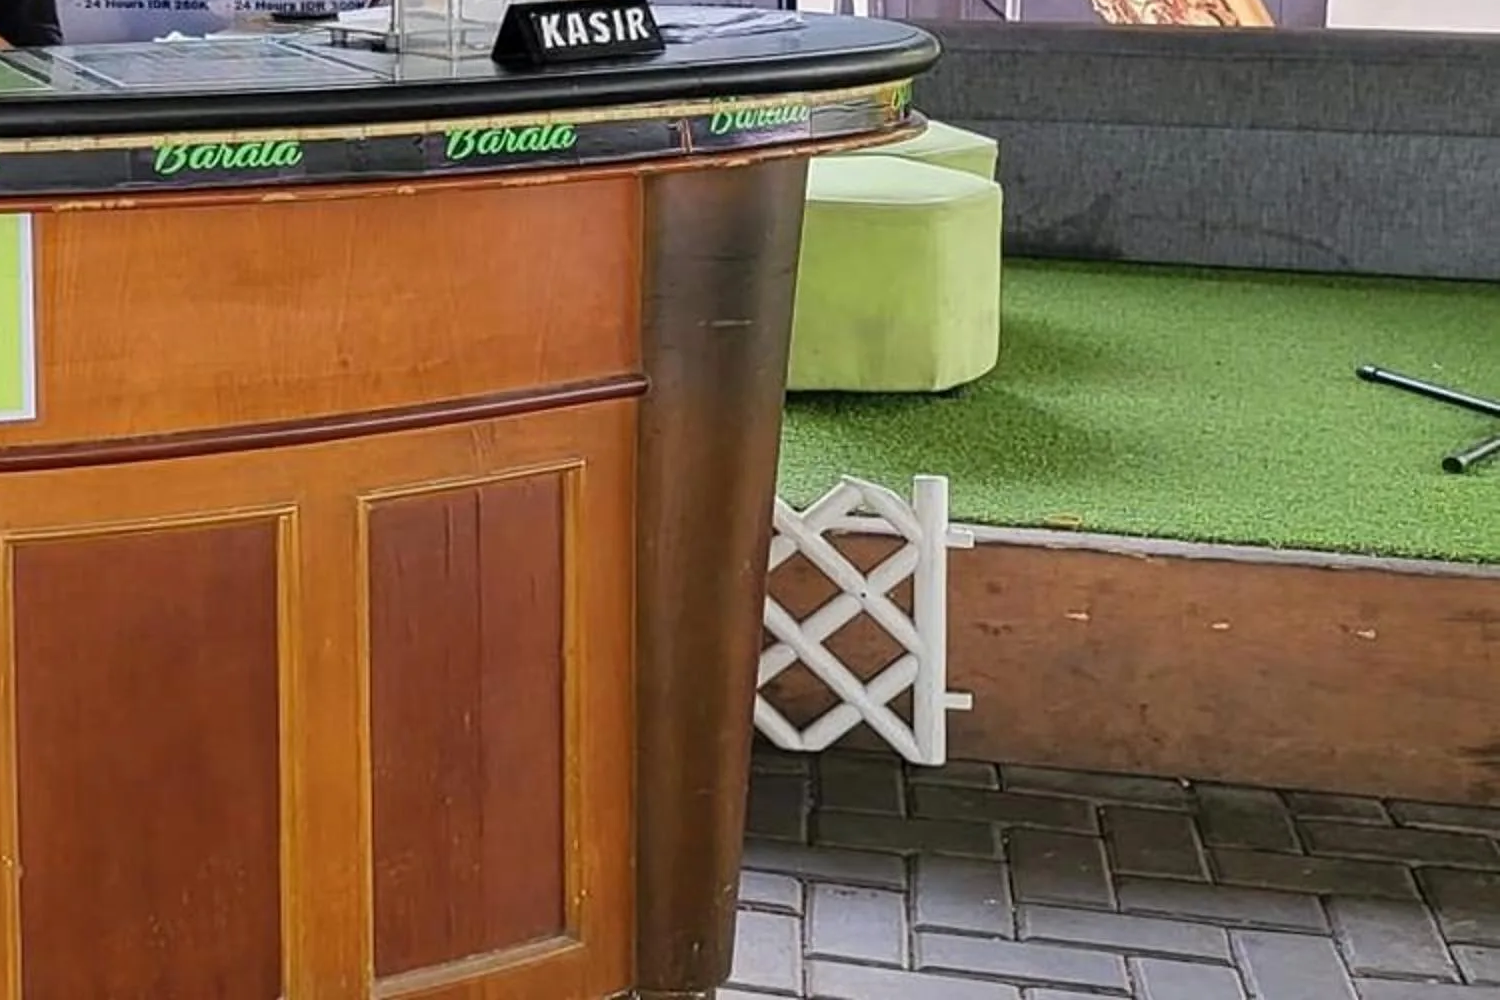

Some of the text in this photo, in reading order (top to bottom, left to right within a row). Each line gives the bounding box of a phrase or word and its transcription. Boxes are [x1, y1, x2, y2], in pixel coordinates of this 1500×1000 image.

[104, 0, 144, 10] Hours
[147, 0, 171, 10] IDR
[540, 6, 651, 50] KASIR
[152, 137, 303, 177] Barata
[445, 122, 578, 162] Barata
